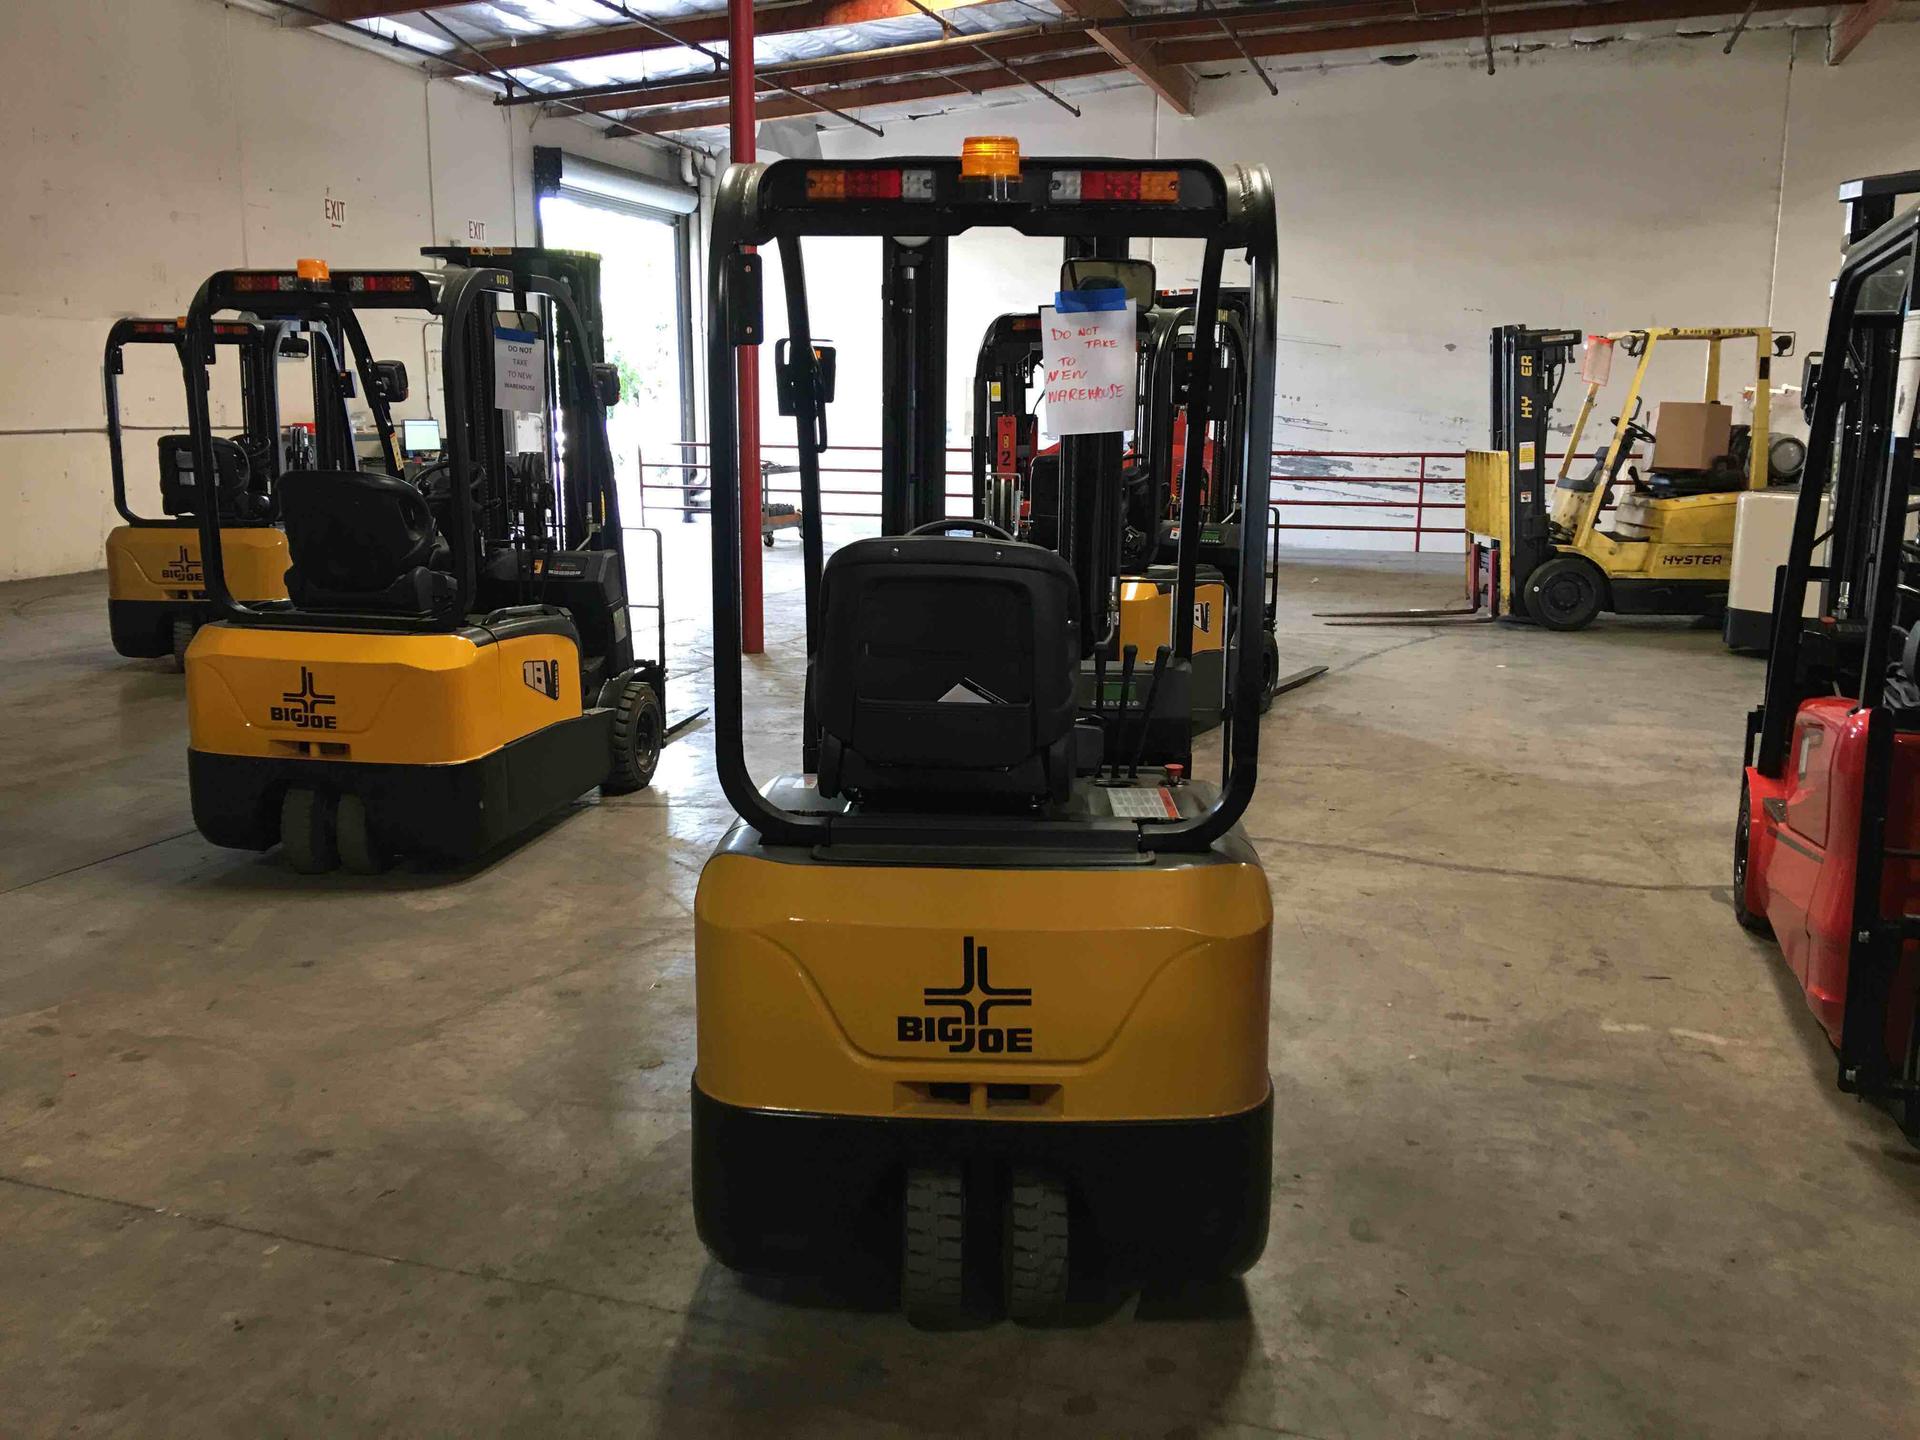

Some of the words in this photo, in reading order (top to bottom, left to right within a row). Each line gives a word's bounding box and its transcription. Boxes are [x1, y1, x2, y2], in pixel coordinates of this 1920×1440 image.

[325, 199, 345, 222] EXIT
[468, 220, 486, 240] EXIT
[1051, 328, 1072, 341] DO
[1078, 326, 1100, 337] NOT
[508, 345, 518, 353] DO
[1084, 340, 1119, 348] TAKE
[512, 358, 528, 367] TAKE
[1058, 357, 1076, 367] TO
[508, 370, 517, 378] TO
[518, 371, 533, 380] NEW
[1046, 370, 1088, 384] NEW
[504, 382, 536, 392] WAREHOUSE
[1048, 383, 1125, 403] WAREHOUSE
[1662, 554, 1723, 566] HYSTER
[270, 706, 303, 722] BIG
[296, 714, 337, 730] JOE
[897, 1015, 963, 1042] BIG
[948, 1027, 1033, 1053] JOE
